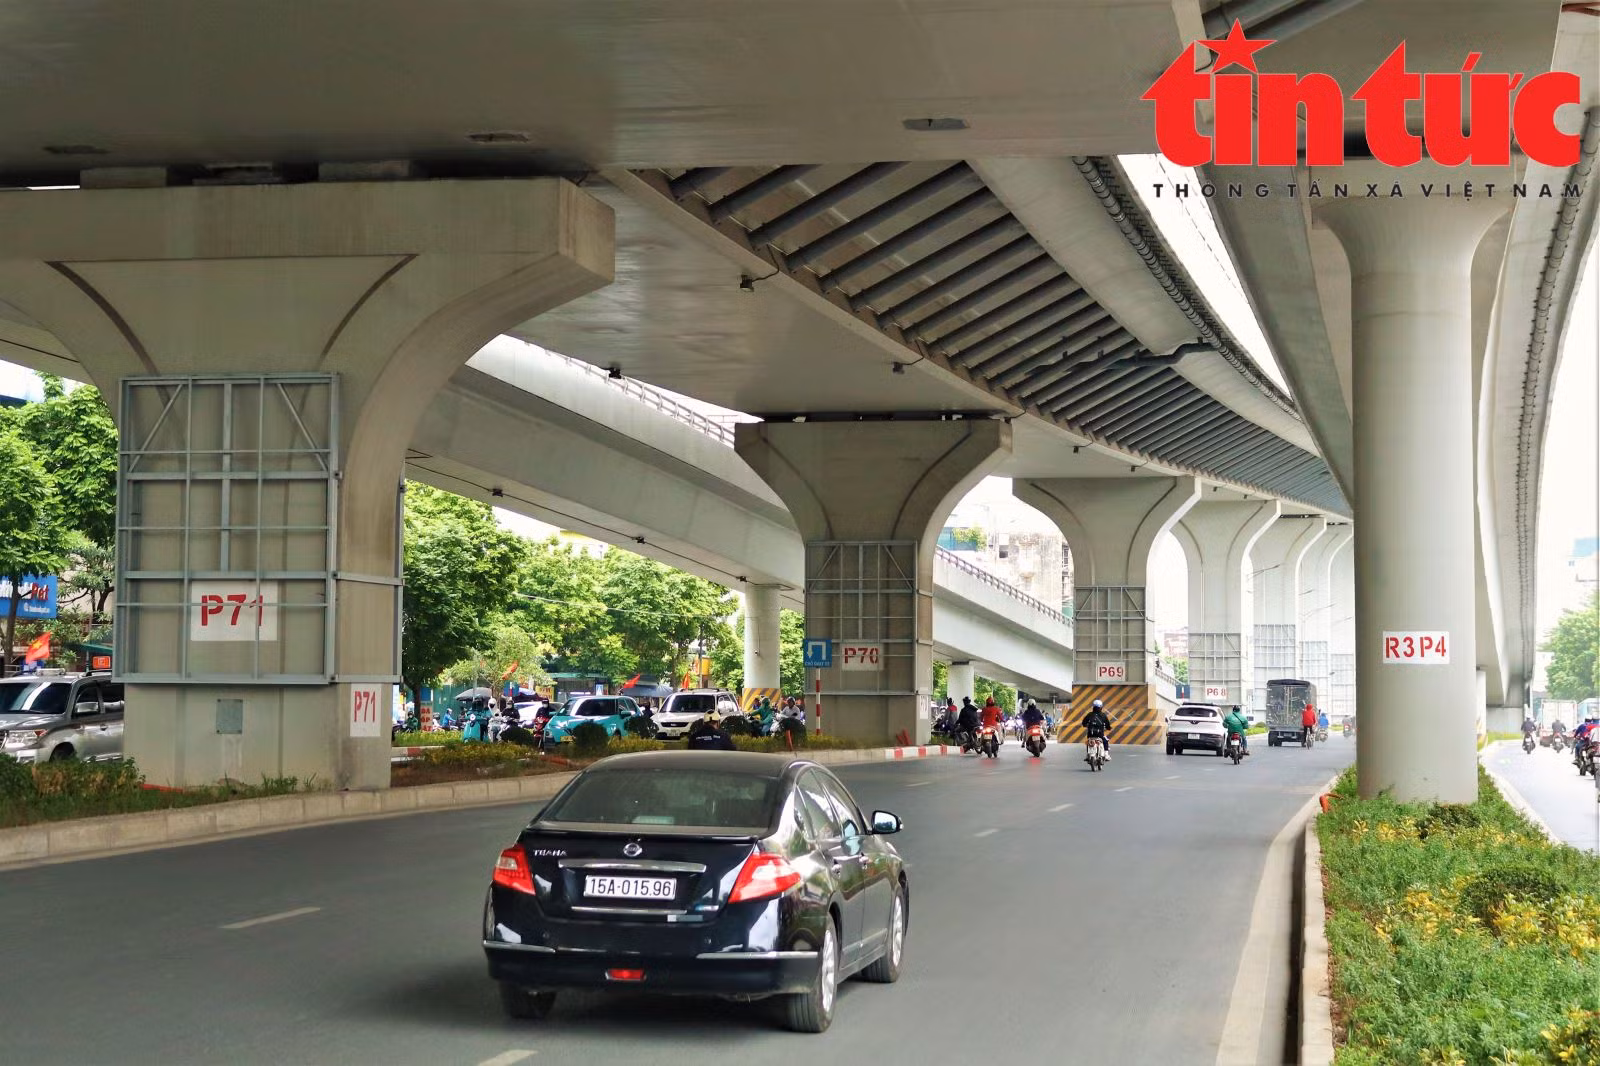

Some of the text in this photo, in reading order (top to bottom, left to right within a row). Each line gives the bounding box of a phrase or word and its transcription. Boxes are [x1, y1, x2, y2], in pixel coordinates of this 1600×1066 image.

[201, 594, 263, 626] P71
[844, 647, 880, 664] P70
[1099, 666, 1124, 678] P69
[354, 691, 376, 723] P71
[591, 878, 672, 897] 15A-015.96
